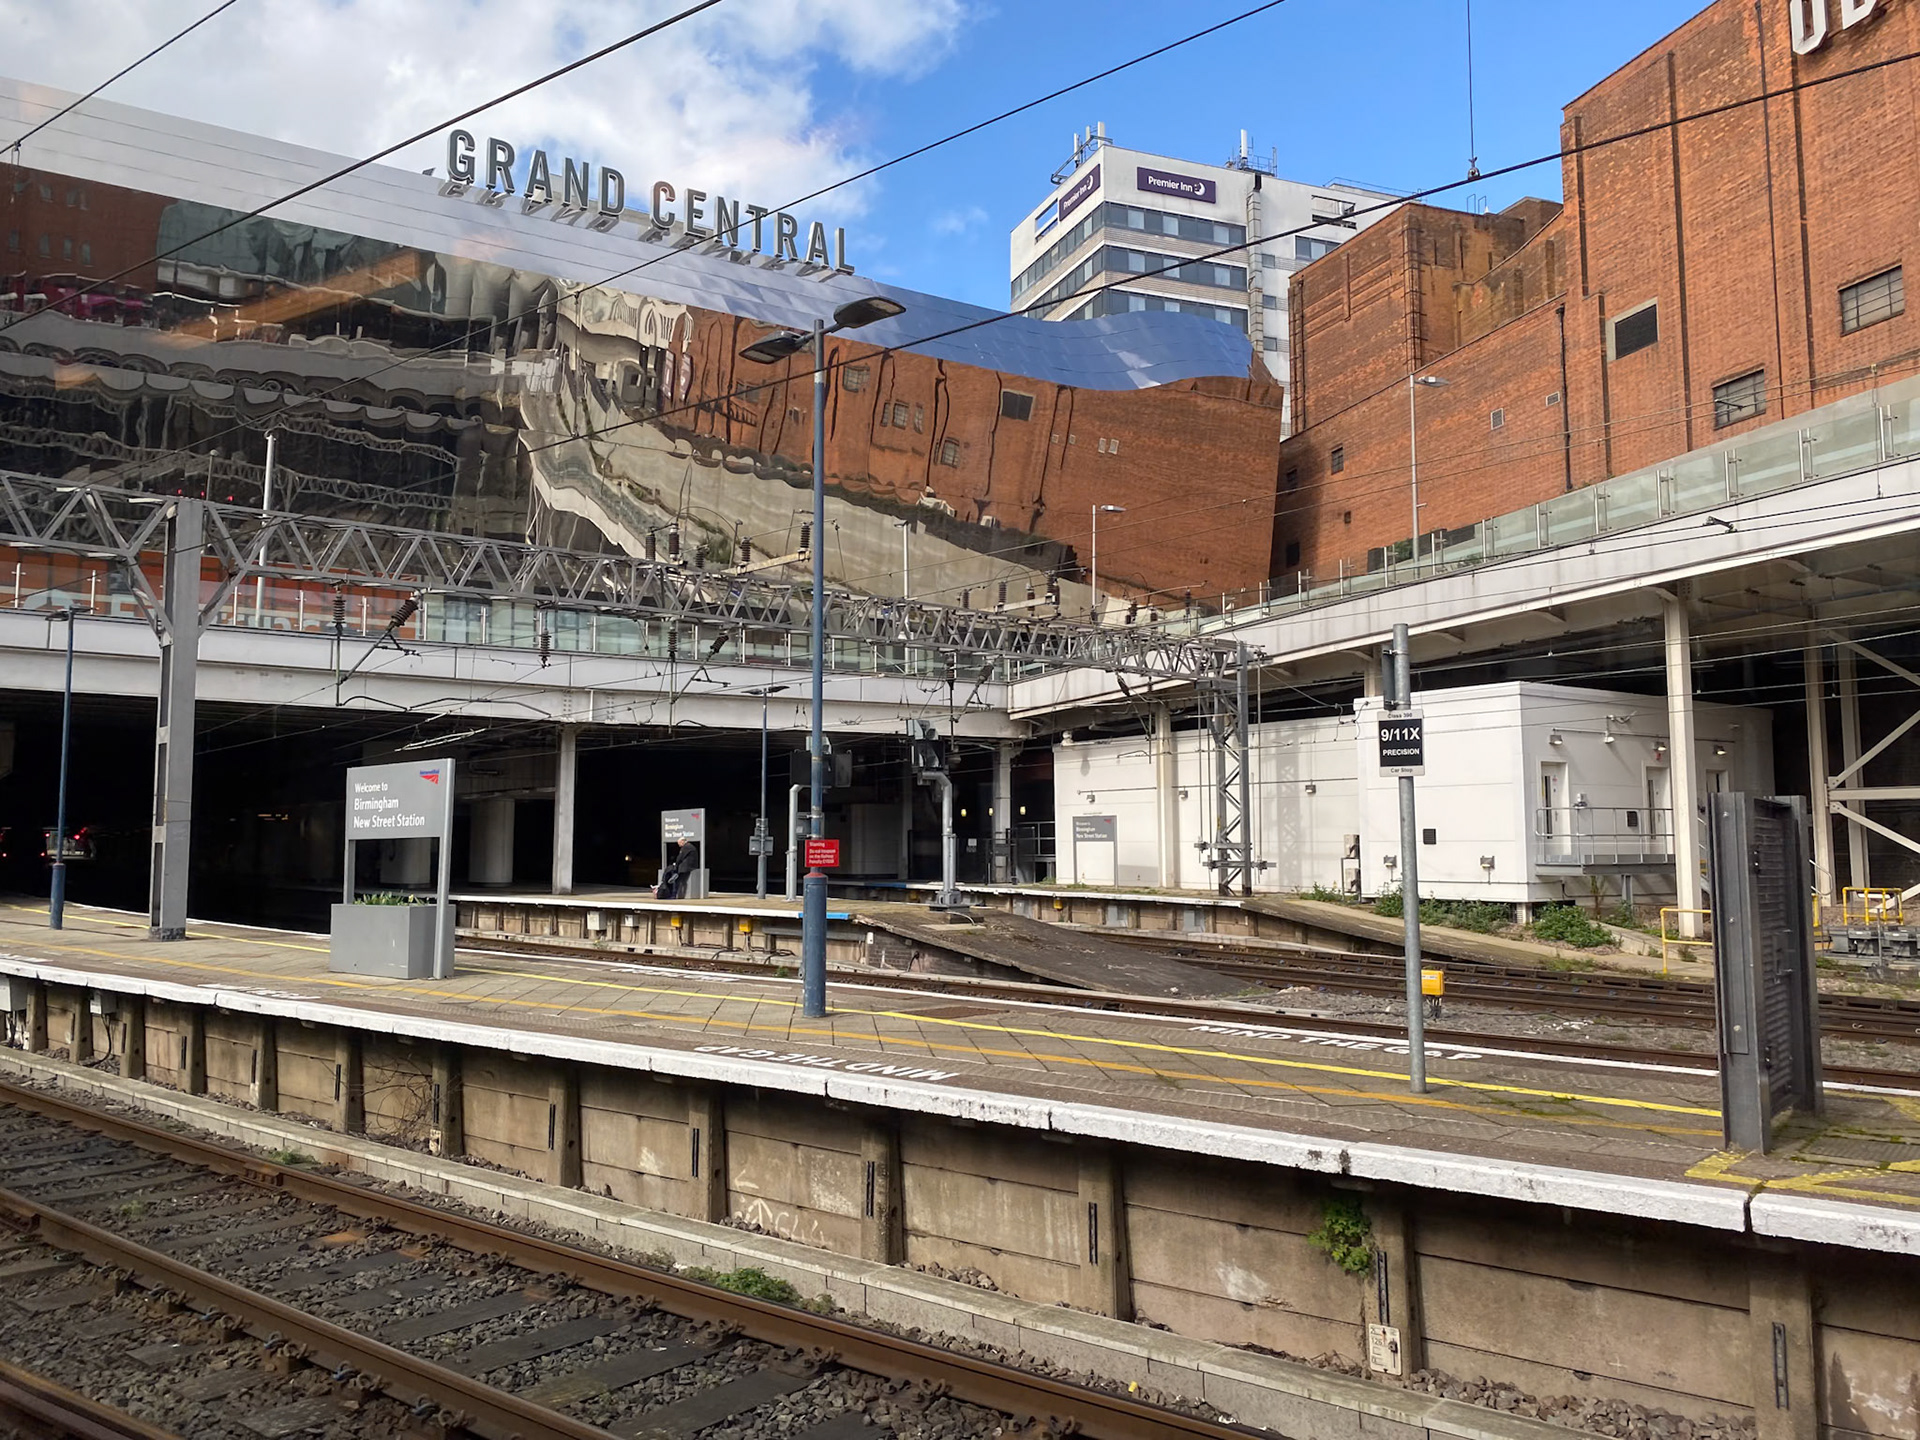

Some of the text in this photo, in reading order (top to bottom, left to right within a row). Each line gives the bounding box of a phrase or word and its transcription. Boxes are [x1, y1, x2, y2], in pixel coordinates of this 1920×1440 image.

[1148, 175, 1193, 193] Premier Inn
[447, 128, 855, 275] GRAND CENTRAL
[1063, 191, 1080, 210] Premier
[1380, 727, 1420, 742] 9/11X
[1382, 748, 1420, 756] PRECISION
[354, 782, 388, 793] Welcome to
[354, 796, 399, 812] Birmingham
[354, 814, 425, 828] New Street Station
[1188, 1025, 1483, 1060] MIND THE GAP
[693, 1044, 960, 1082] MIND THE GAP
